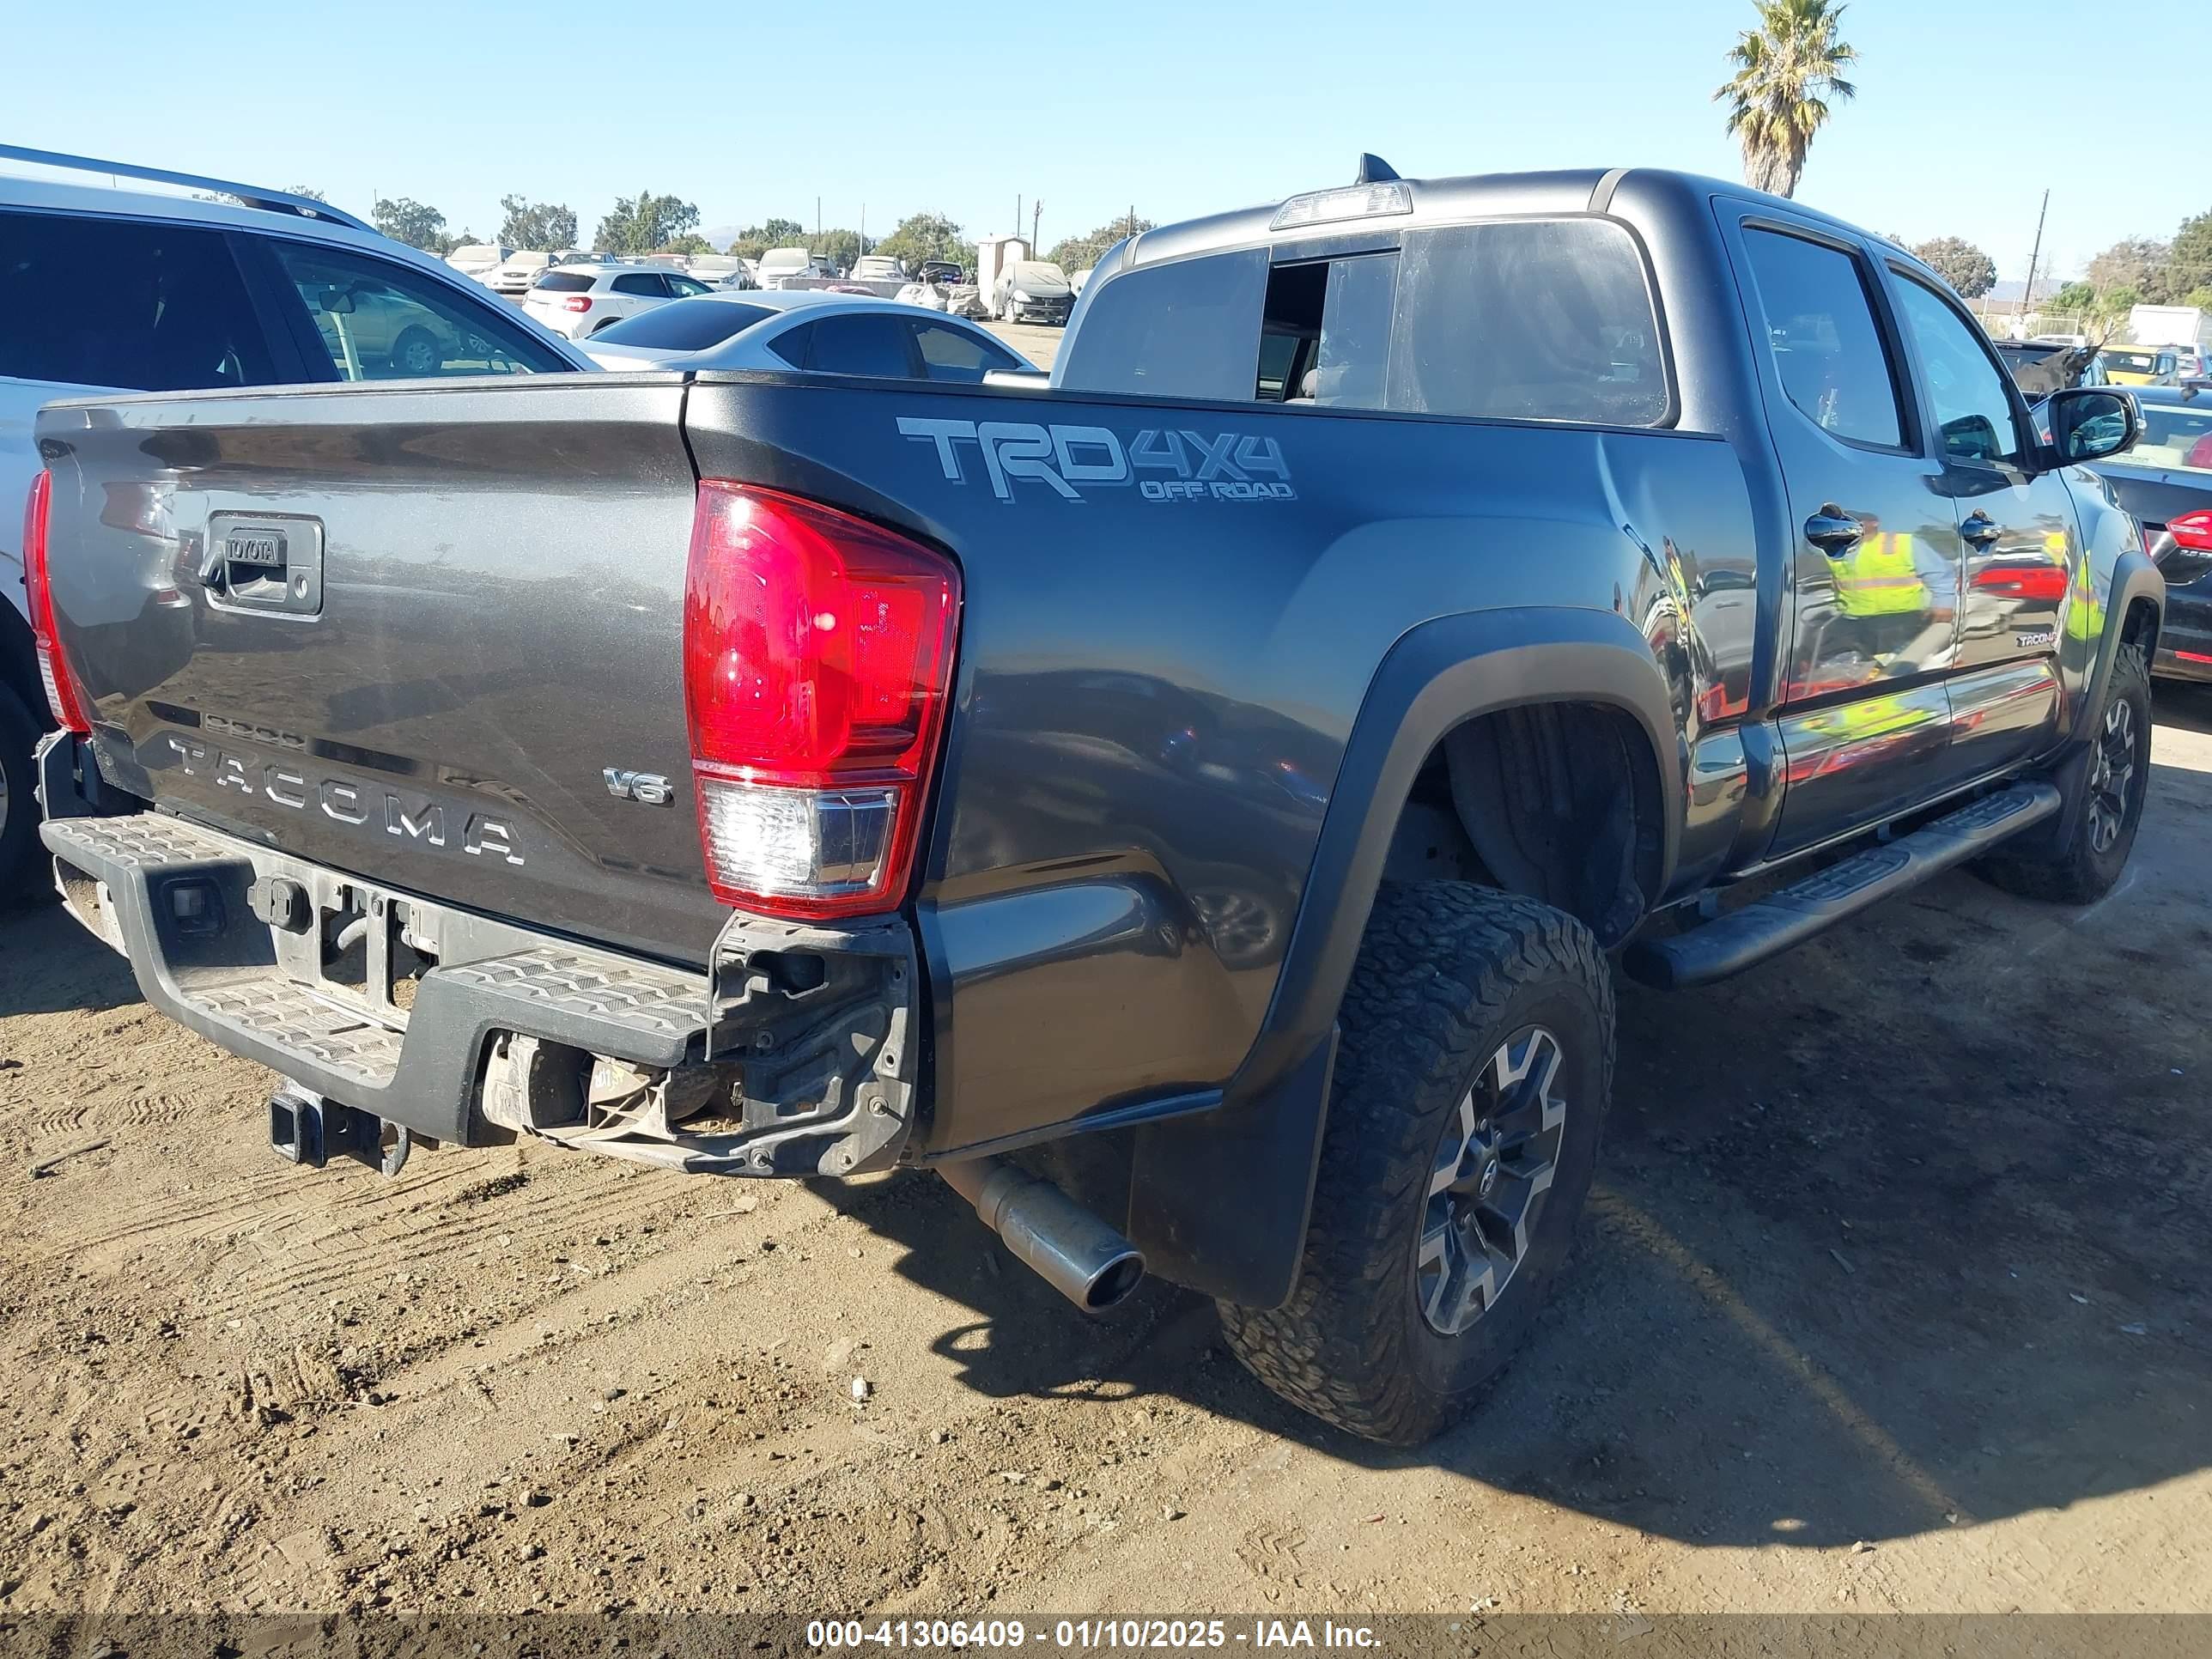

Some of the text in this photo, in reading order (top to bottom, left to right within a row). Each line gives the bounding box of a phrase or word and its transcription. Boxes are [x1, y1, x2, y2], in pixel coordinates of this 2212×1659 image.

[896, 417, 1127, 502] TRD
[1140, 481, 1295, 501] OFF ROAD
[228, 538, 276, 562] TOYOTA
[167, 738, 526, 866] TACOMA
[602, 767, 673, 804] V6
